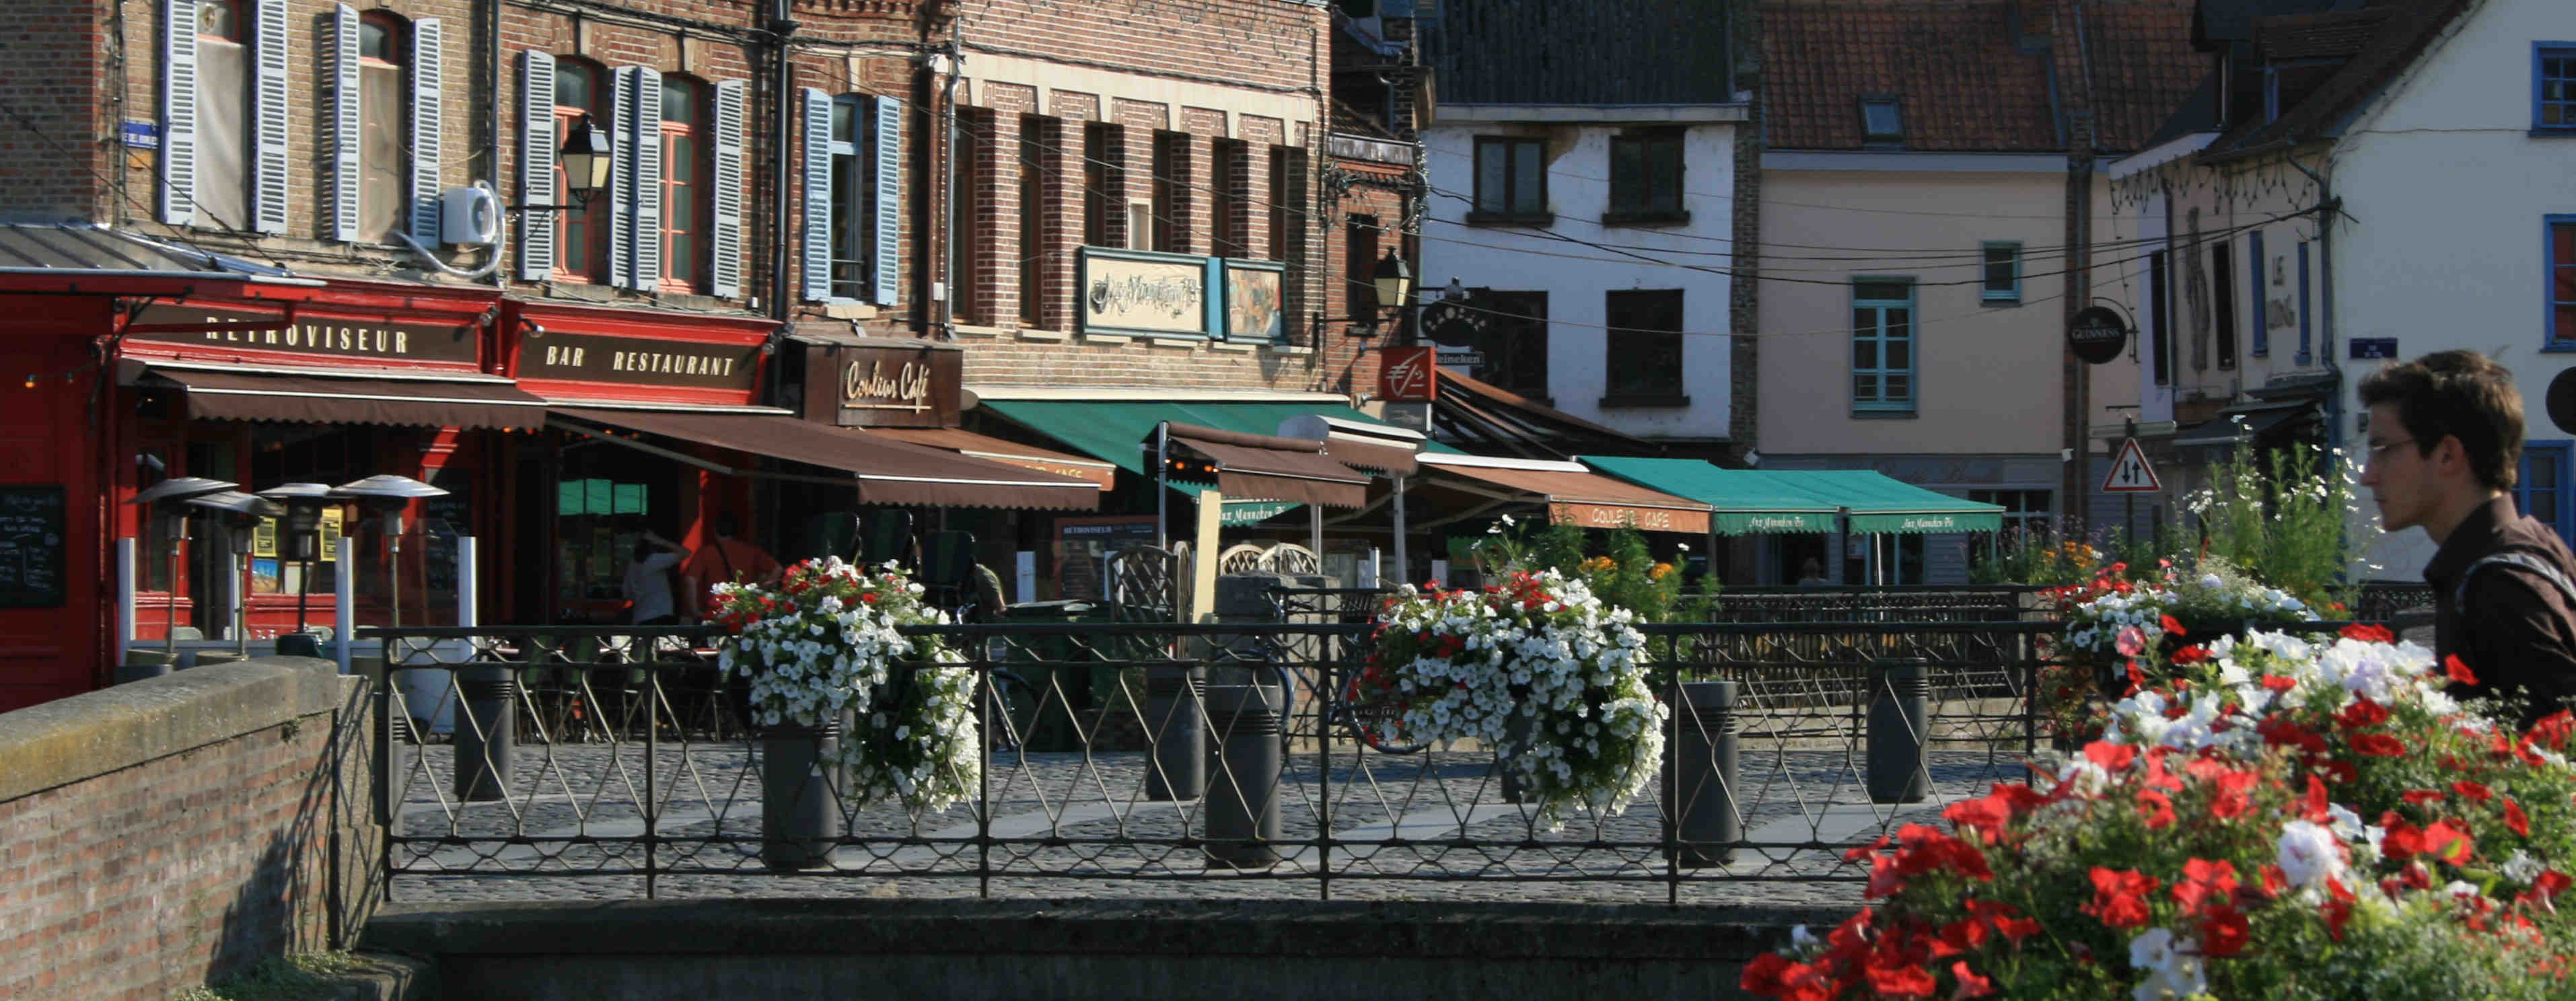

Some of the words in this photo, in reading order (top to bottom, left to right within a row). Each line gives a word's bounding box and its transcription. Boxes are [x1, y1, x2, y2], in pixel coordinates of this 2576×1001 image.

[2072, 328, 2117, 339] GUINNESS
[546, 346, 583, 367] BAR
[613, 351, 733, 376] RESTAURANT
[1435, 355, 1480, 363] eineken
[900, 361, 930, 414] Café
